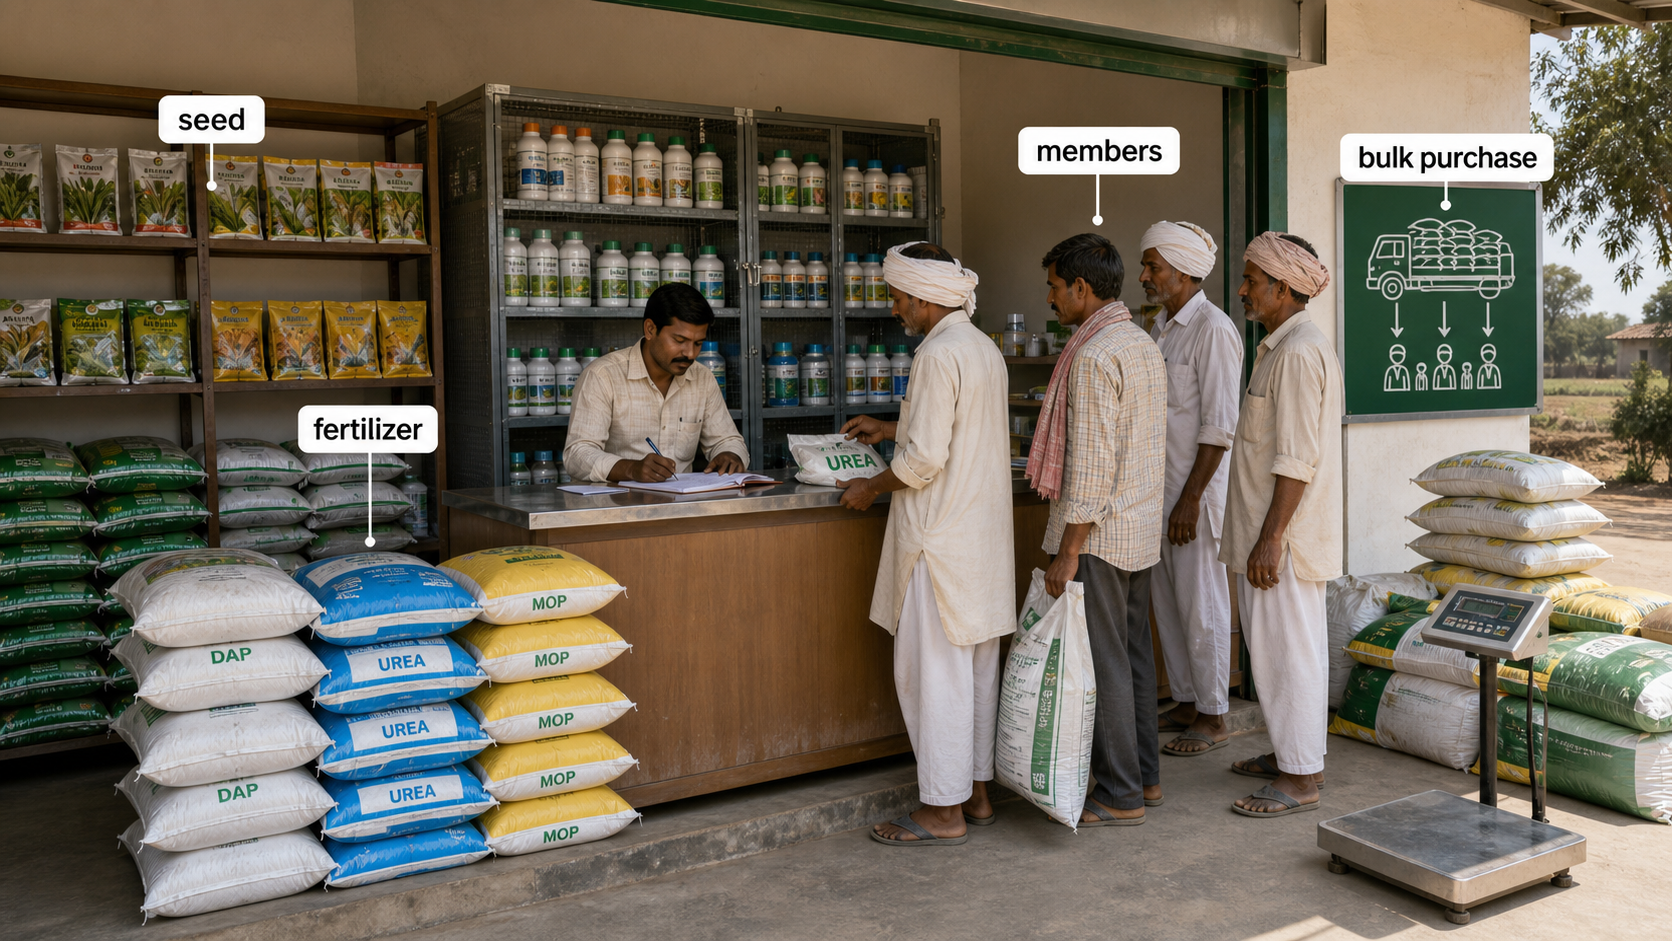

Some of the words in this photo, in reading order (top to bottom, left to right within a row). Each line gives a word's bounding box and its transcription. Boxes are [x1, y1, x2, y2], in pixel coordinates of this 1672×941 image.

[825, 453, 878, 471] UREA
[531, 594, 568, 611] MOP
[210, 647, 252, 665] DAP
[377, 653, 427, 672] UREA
[534, 651, 570, 668] MOP
[381, 719, 430, 739] UREA
[537, 712, 575, 730] MOP
[539, 770, 576, 788] MOP
[216, 783, 259, 803] DAP
[389, 784, 437, 804] UREA
[542, 825, 580, 844] MOP
